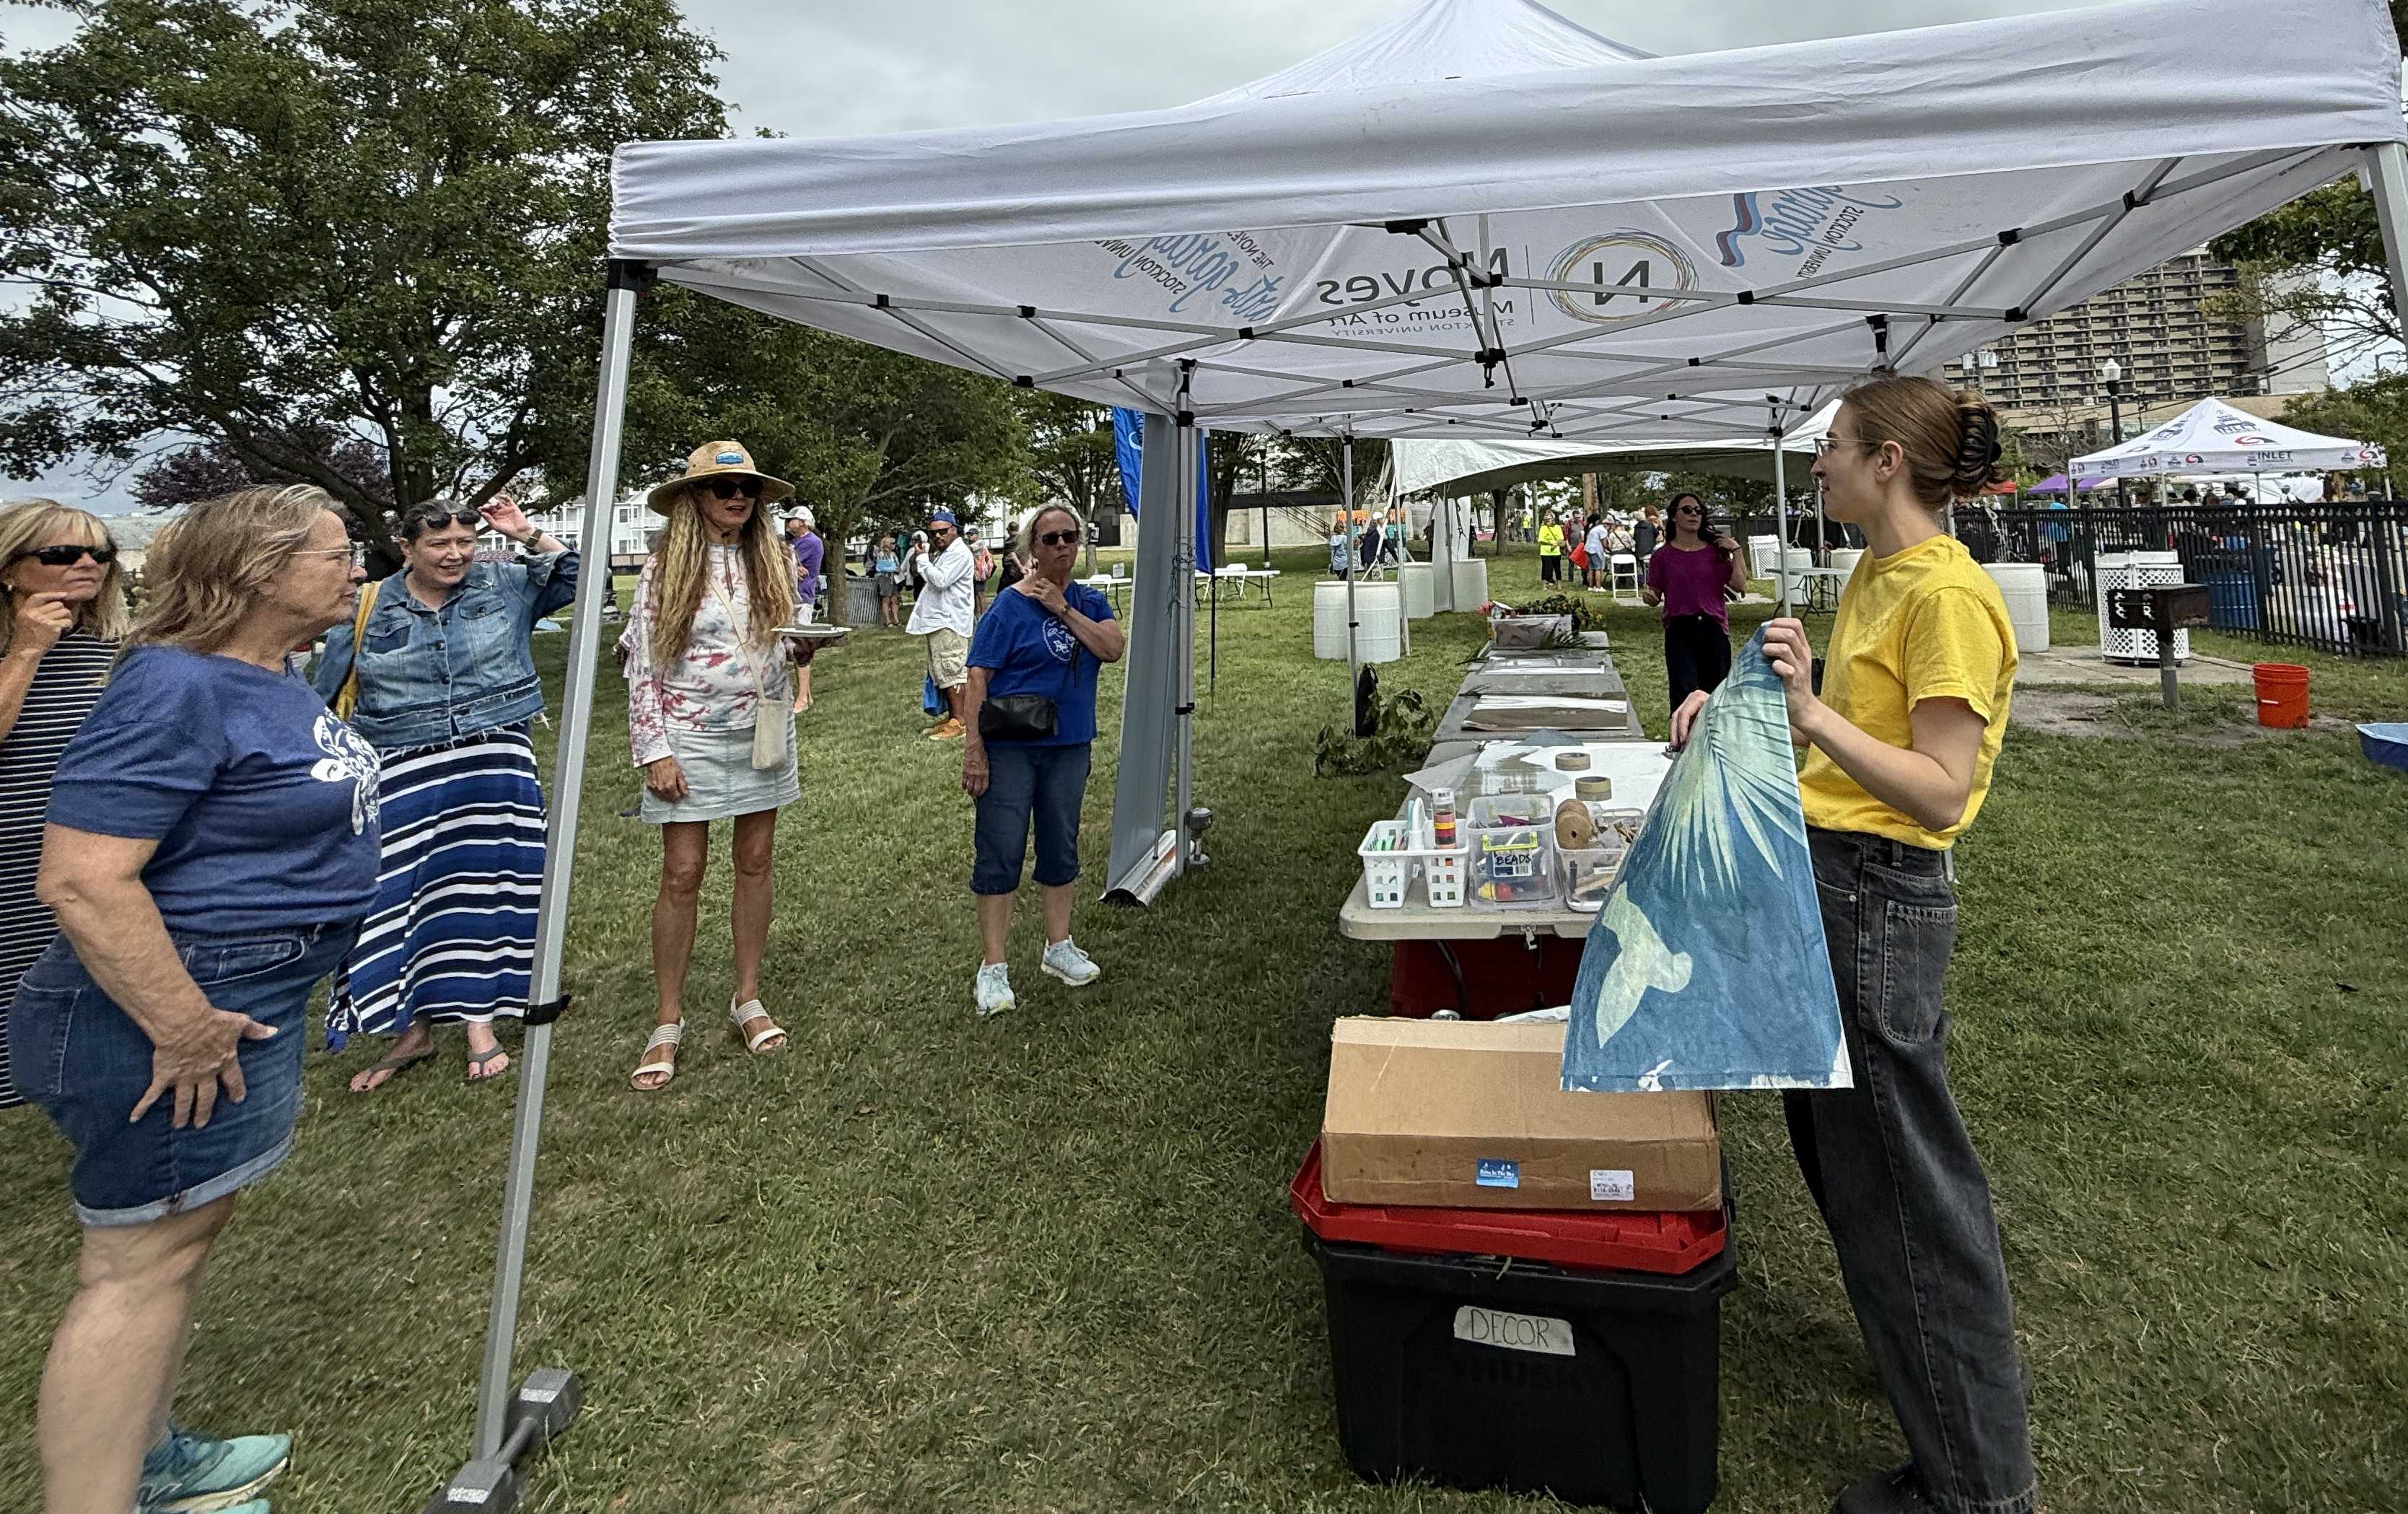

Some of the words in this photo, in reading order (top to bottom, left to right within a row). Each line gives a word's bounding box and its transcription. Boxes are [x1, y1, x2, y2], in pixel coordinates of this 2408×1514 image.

[2258, 450, 2293, 459] INLET
[1496, 854, 1531, 865] BEADS
[1471, 1309, 1549, 1348] DECOR
